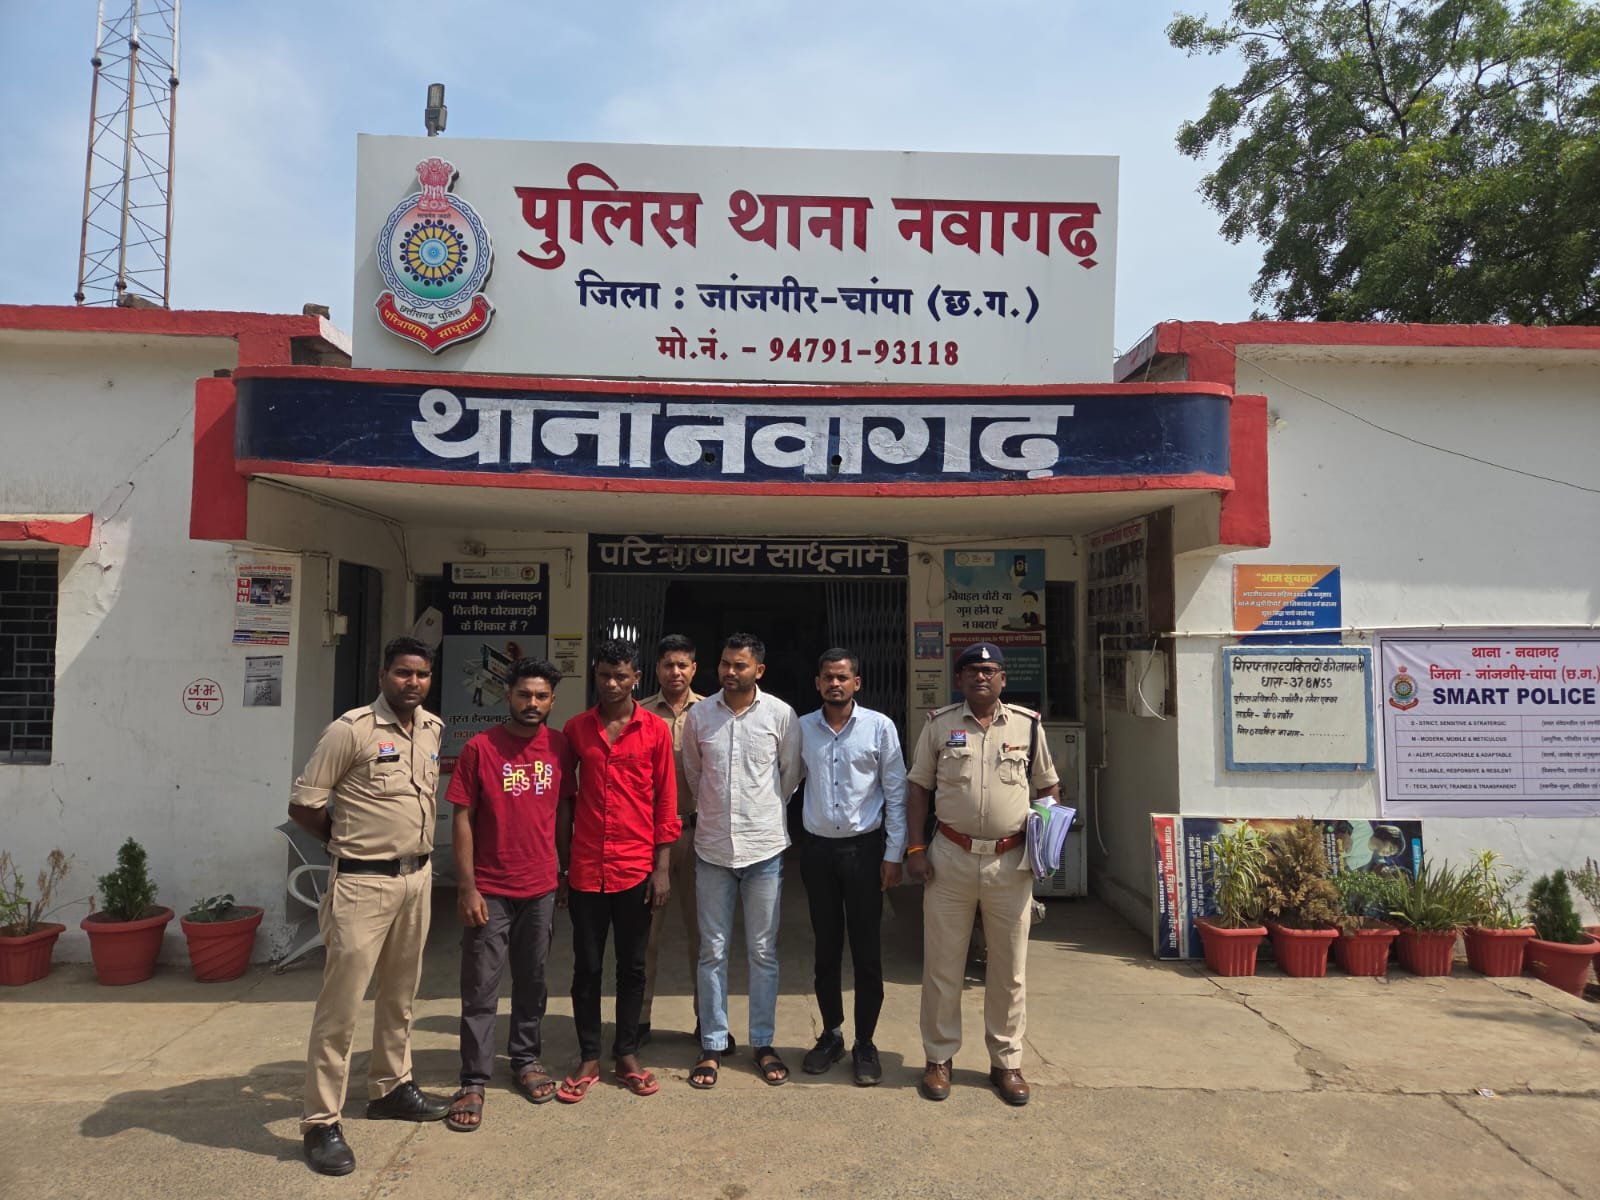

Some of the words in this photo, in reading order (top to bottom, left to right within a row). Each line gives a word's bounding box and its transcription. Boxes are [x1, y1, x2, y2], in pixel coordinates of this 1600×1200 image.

[514, 163, 703, 270] पुलिस
[728, 190, 874, 253] थाना
[891, 198, 1101, 269] नवागढ़
[575, 269, 661, 310] जिला
[696, 272, 914, 316] जांजगीर-चांपा
[928, 284, 1039, 324] (छ.ग.)
[656, 326, 728, 360] मो.नं.
[770, 337, 959, 366] 94791-93118
[411, 388, 661, 468] थाना
[664, 403, 1075, 480] नवागढ़
[448, 591, 467, 600] क्या
[471, 592, 491, 600] आप
[1001, 592, 1012, 600] या
[956, 606, 971, 617] गुम
[974, 604, 990, 615] होने
[992, 606, 1003, 615] पर
[461, 621, 471, 631] के
[474, 620, 506, 631] शिकार
[962, 621, 969, 629] न
[1472, 647, 1501, 658] थाना
[1515, 647, 1559, 662] नवागढ़
[1429, 664, 1462, 680] जिला
[1433, 688, 1509, 705] SMART
[1517, 688, 1596, 705] POLICE
